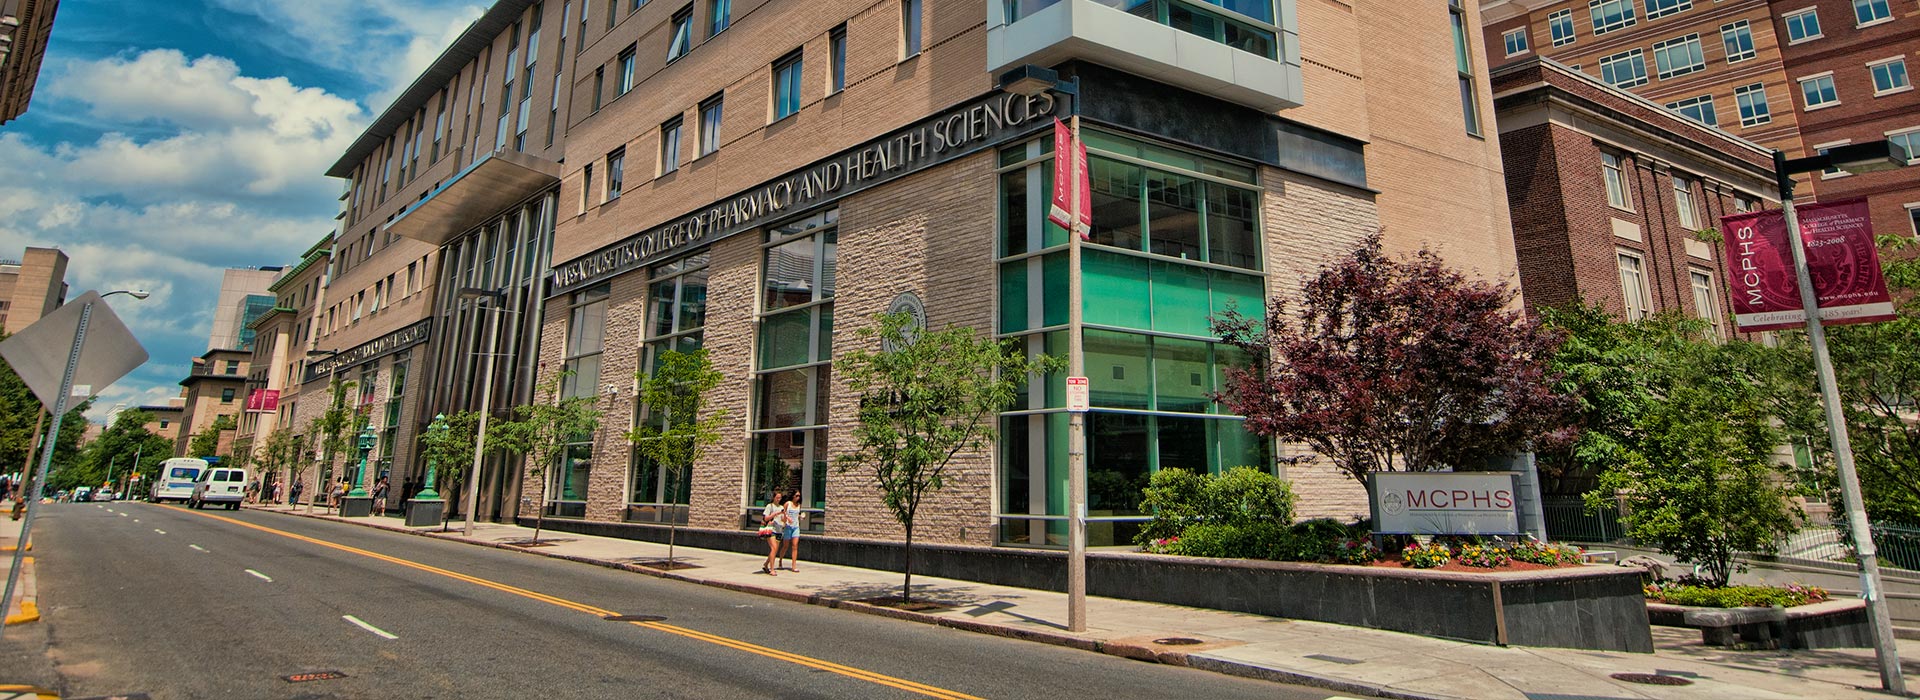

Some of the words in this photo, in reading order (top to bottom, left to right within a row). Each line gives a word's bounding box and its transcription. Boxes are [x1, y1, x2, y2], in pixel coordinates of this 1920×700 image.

[553, 242, 632, 289] MASSACHUSETTS
[633, 221, 687, 260] COLLEGE
[687, 213, 708, 243] OF
[709, 177, 796, 234] PHARMACY
[799, 161, 842, 202] AND
[846, 127, 926, 185] HEALTH
[933, 91, 1056, 153] SCIENCES
[1807, 235, 1846, 248] 1823-2008
[1738, 226, 1764, 305] MCPHS
[1752, 313, 1802, 323] Celebrating
[1824, 310, 1839, 318] 185
[1406, 490, 1512, 508] MCPHS
